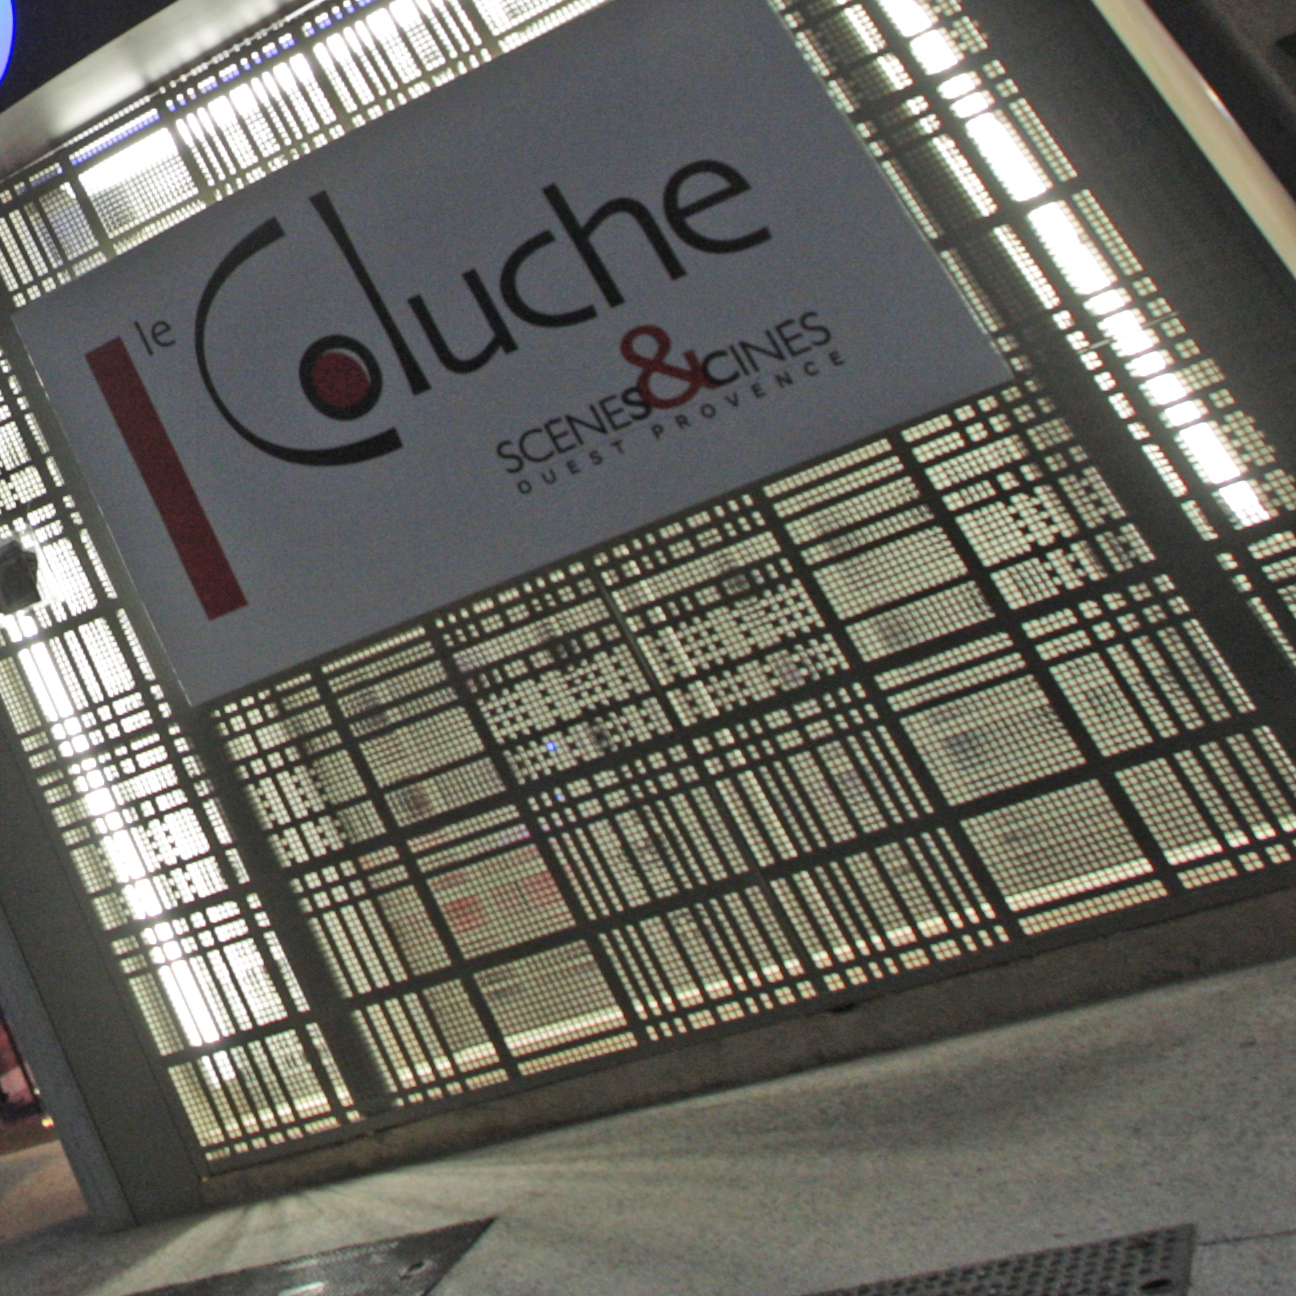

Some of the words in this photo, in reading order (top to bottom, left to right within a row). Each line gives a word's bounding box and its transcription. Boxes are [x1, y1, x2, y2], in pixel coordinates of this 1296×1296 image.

[133, 319, 176, 356] le
[194, 158, 773, 467] Coluche
[517, 439, 626, 495] OUEST
[650, 350, 846, 441] PROVENCE
